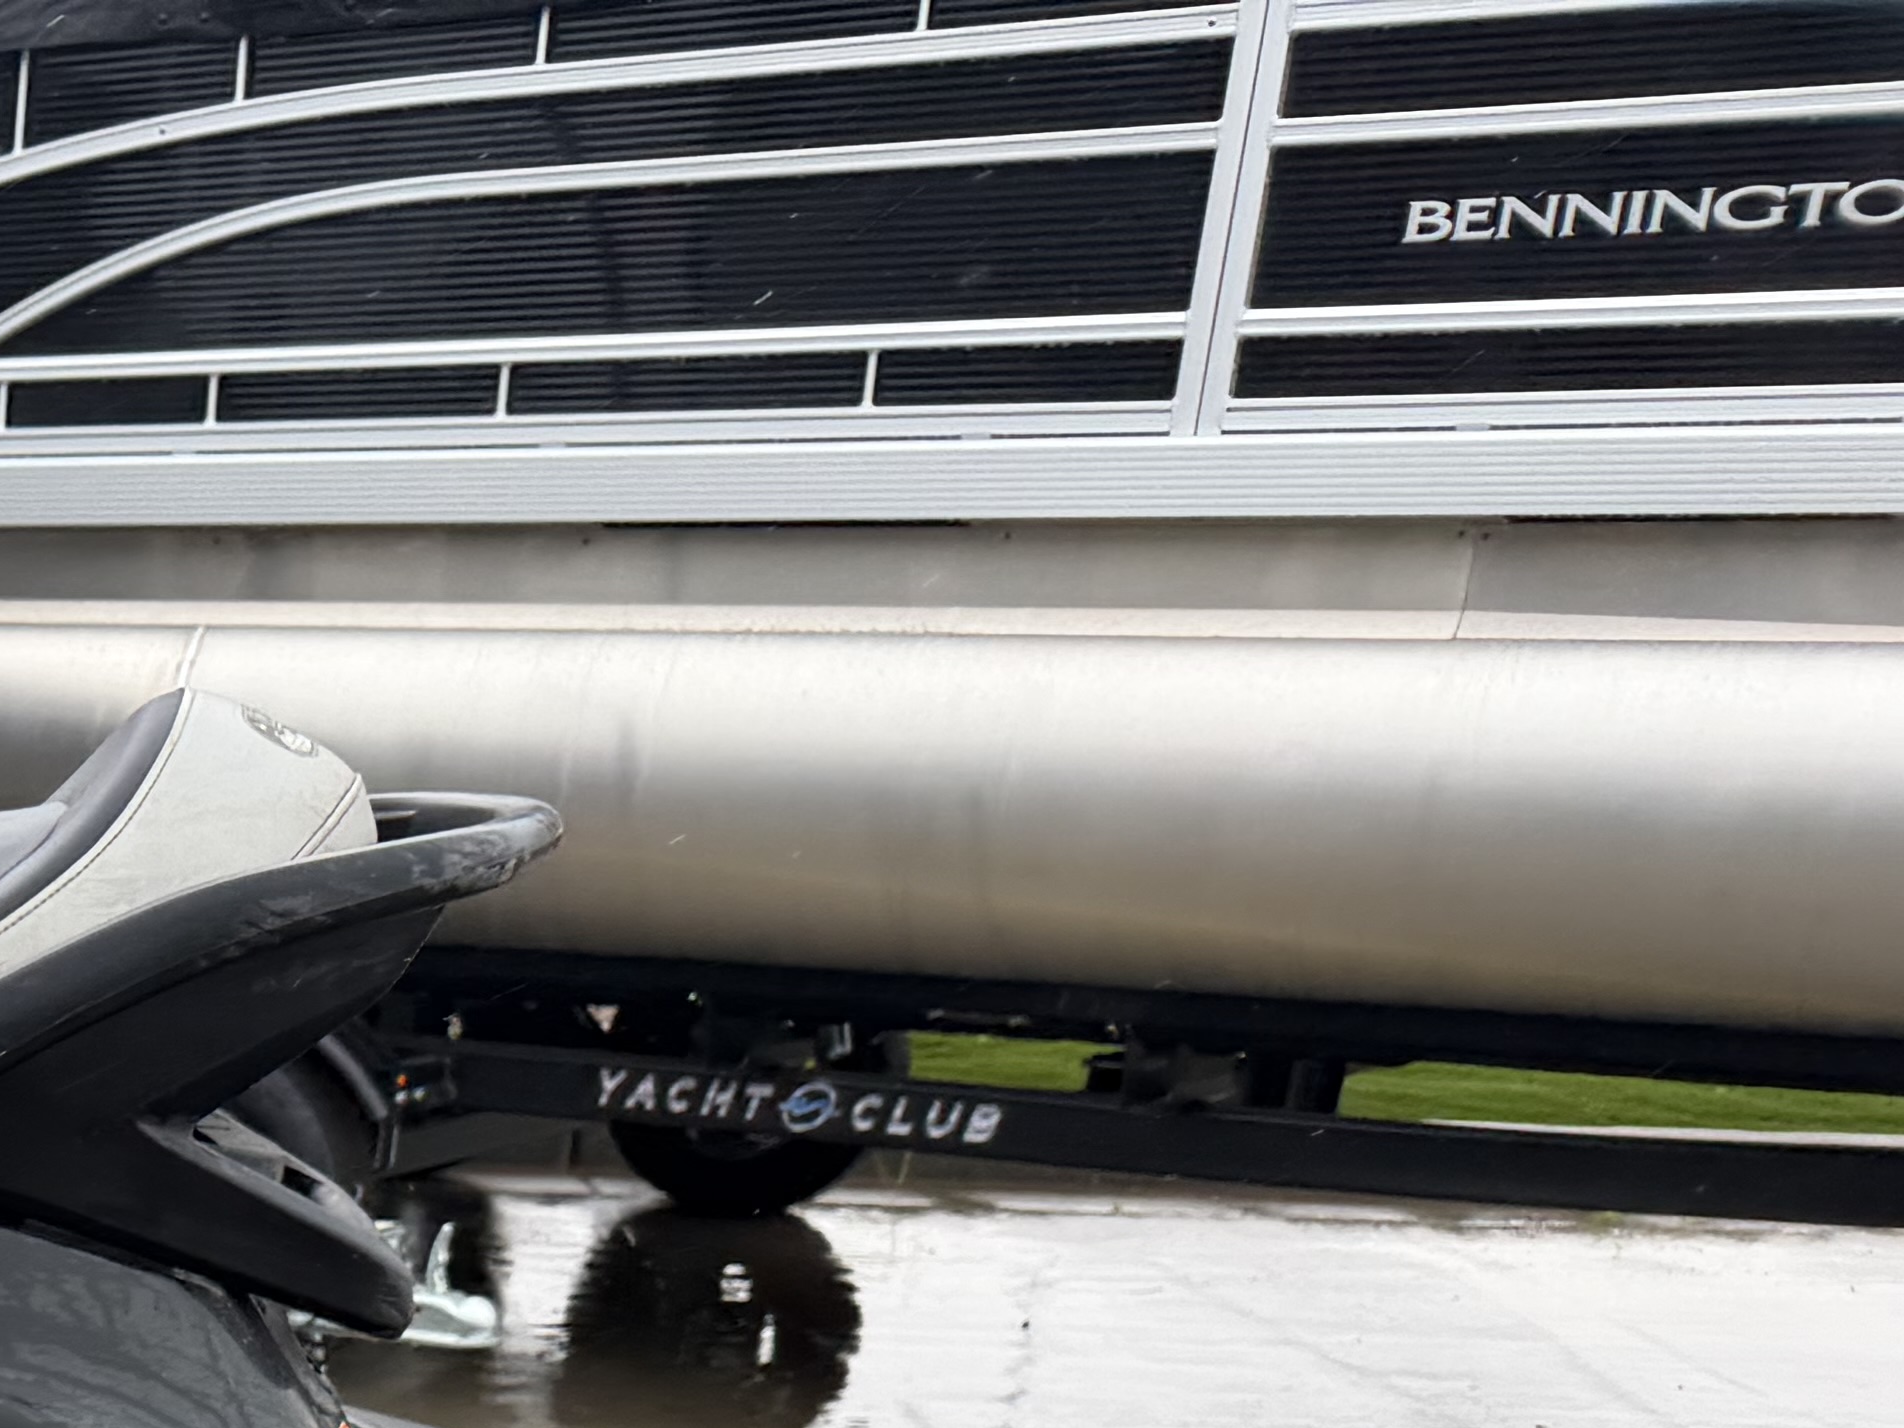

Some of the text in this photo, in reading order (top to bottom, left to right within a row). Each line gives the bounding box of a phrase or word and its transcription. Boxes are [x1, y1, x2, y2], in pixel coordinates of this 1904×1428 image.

[1401, 178, 1904, 244] BENNINGTO
[597, 1067, 1003, 1144] YACHT CLUB
